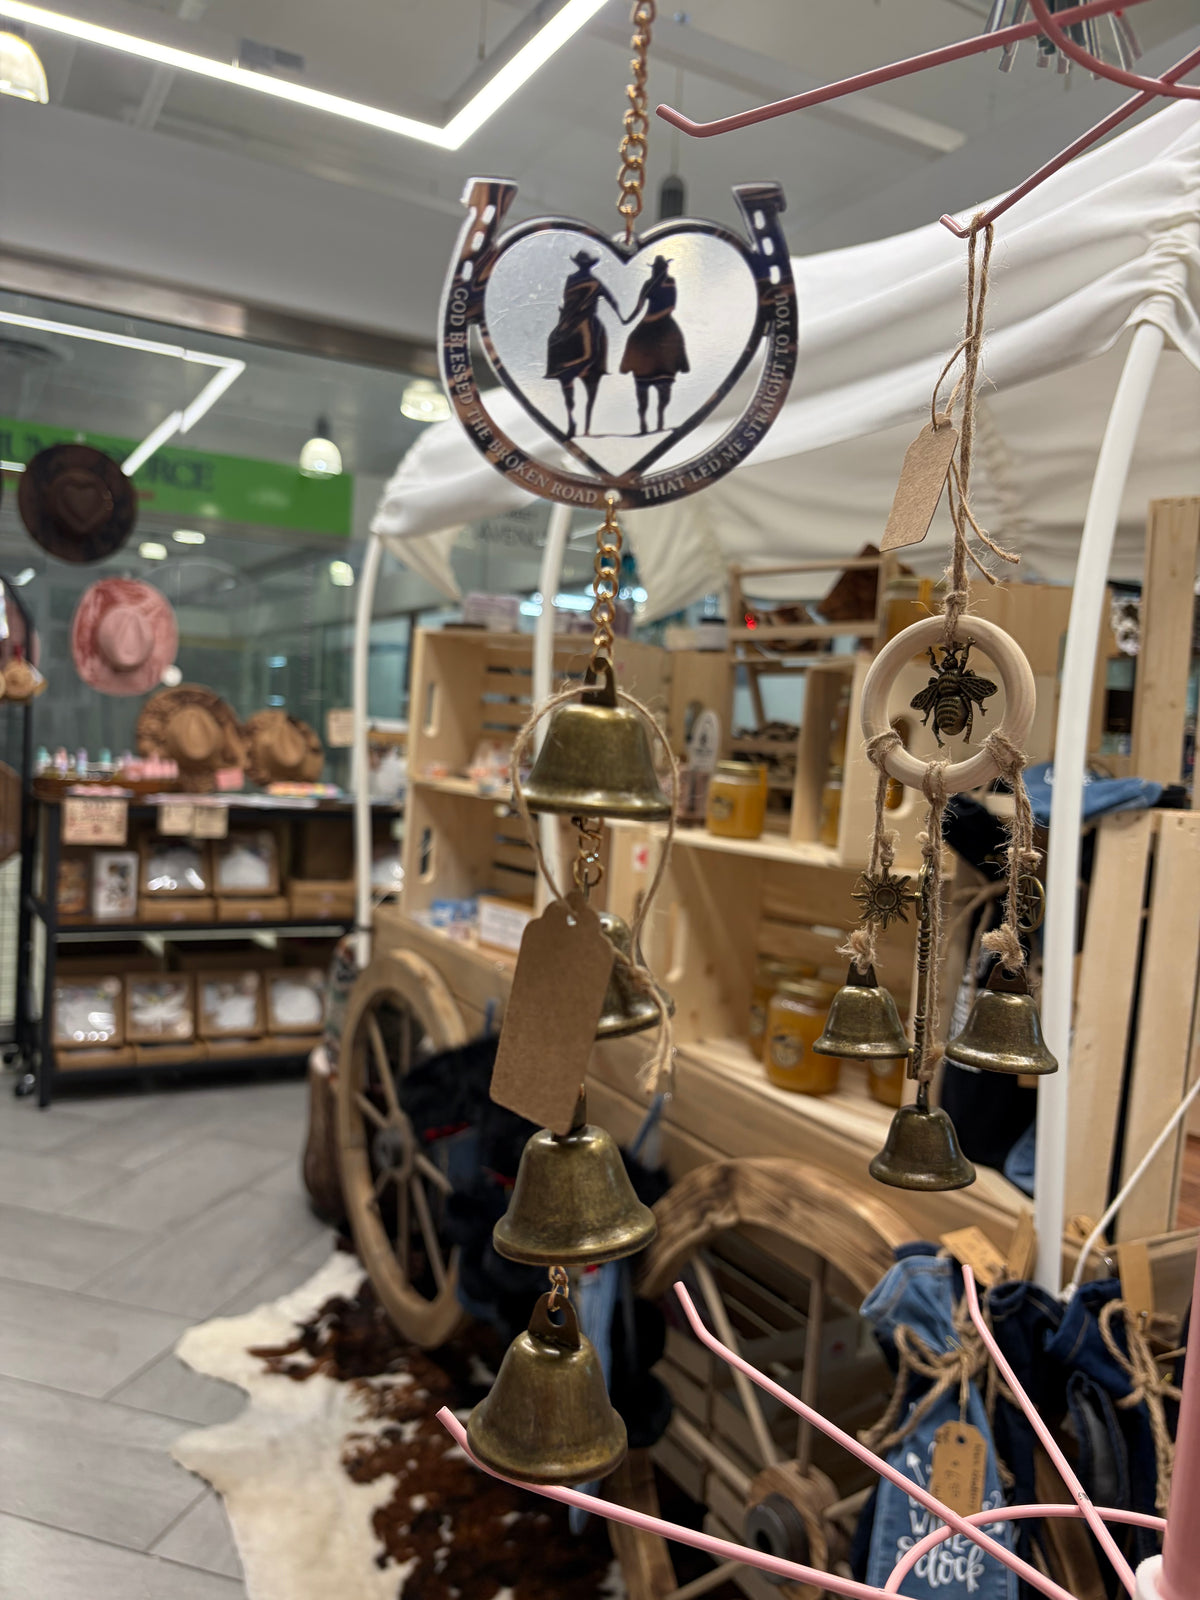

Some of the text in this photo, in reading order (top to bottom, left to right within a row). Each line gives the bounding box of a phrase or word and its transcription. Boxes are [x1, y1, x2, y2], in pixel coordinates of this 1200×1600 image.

[449, 286, 469, 326] GOD
[449, 332, 475, 406] BLESSED
[641, 294, 791, 500] THAT LED ME STRAIGHT TO YOU
[466, 407, 493, 441] THE
[487, 437, 550, 489] BROKEN
[551, 483, 599, 505] ROAD
